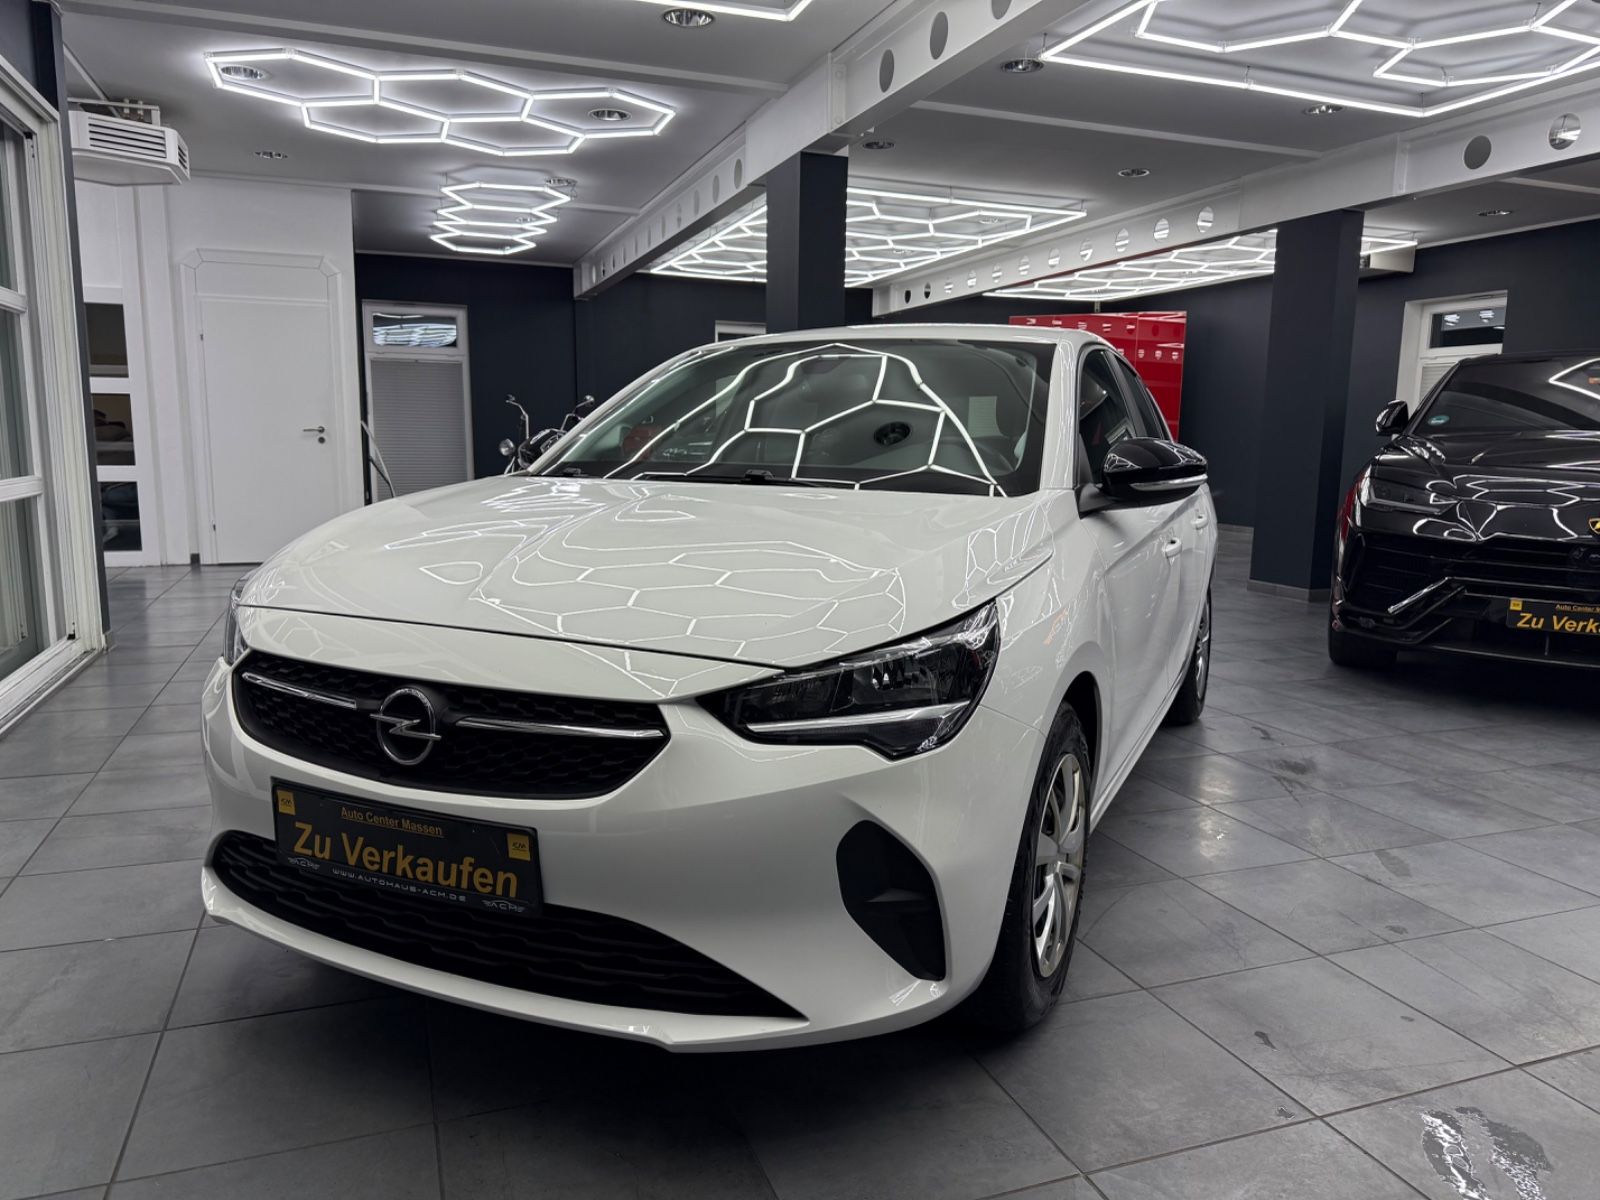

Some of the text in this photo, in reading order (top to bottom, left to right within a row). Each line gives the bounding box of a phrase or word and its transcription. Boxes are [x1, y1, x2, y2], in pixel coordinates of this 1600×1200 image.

[1517, 612, 1600, 634] Zu Verk
[341, 807, 443, 836] Auto Center Massen
[293, 821, 519, 898] Zu Verkaufen
